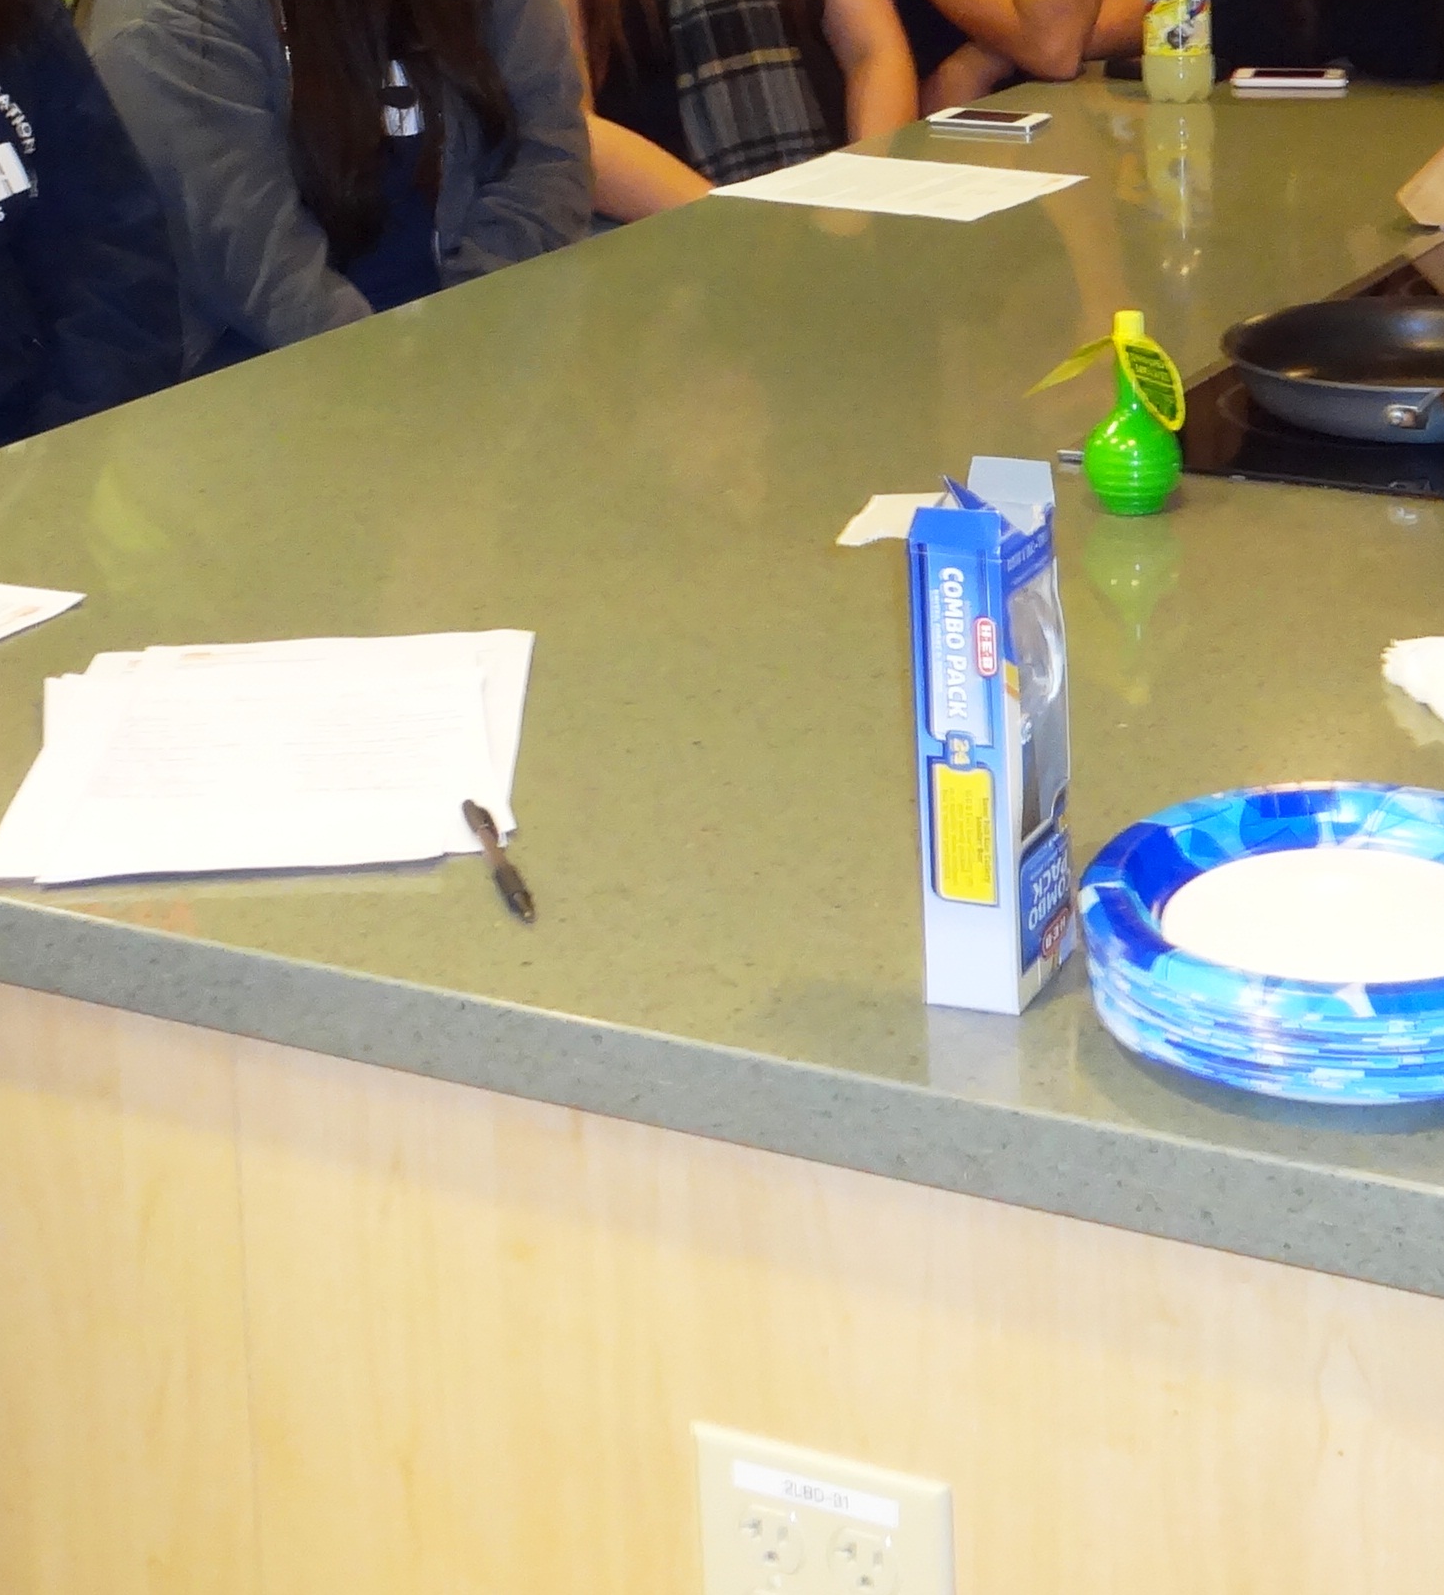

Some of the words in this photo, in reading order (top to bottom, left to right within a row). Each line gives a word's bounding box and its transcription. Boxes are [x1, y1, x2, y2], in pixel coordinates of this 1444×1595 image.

[941, 567, 965, 650] COMBO
[946, 654, 968, 719] PACK
[1032, 850, 1069, 902] PACK
